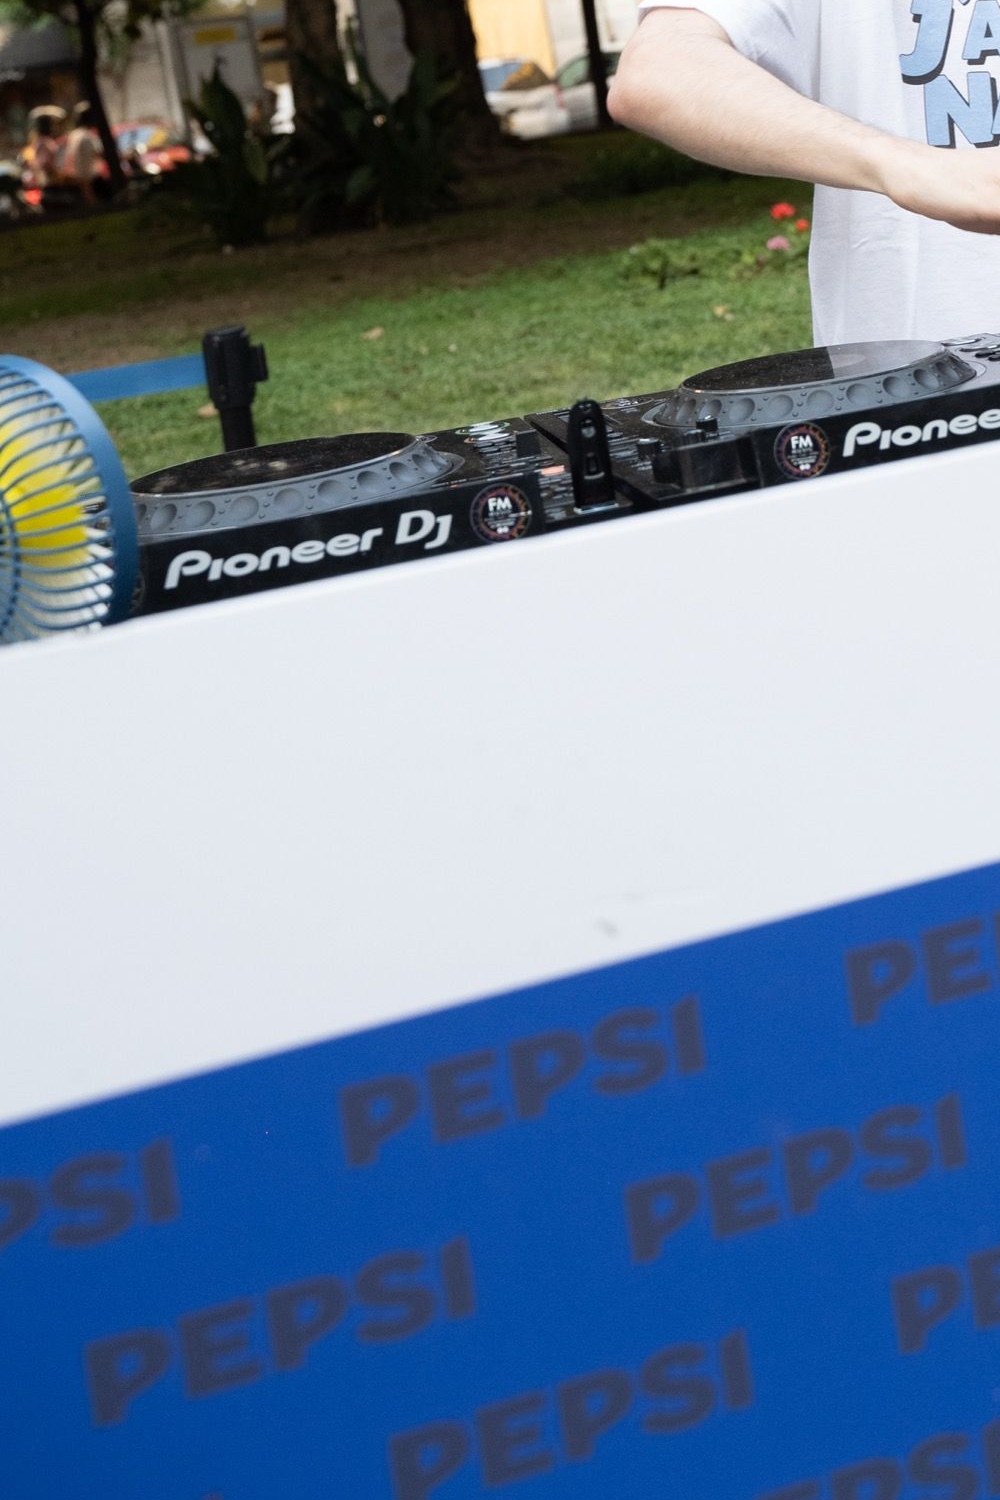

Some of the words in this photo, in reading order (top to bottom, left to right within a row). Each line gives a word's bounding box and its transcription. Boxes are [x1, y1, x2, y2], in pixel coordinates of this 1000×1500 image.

[487, 495, 513, 512] FM
[790, 434, 814, 450] FM
[163, 527, 384, 590] Pioneer
[340, 998, 705, 1166] PEPSI
[625, 1095, 966, 1262] PEPSI
[86, 1239, 475, 1424] PEPSI
[390, 1331, 752, 1500] PEPSI
